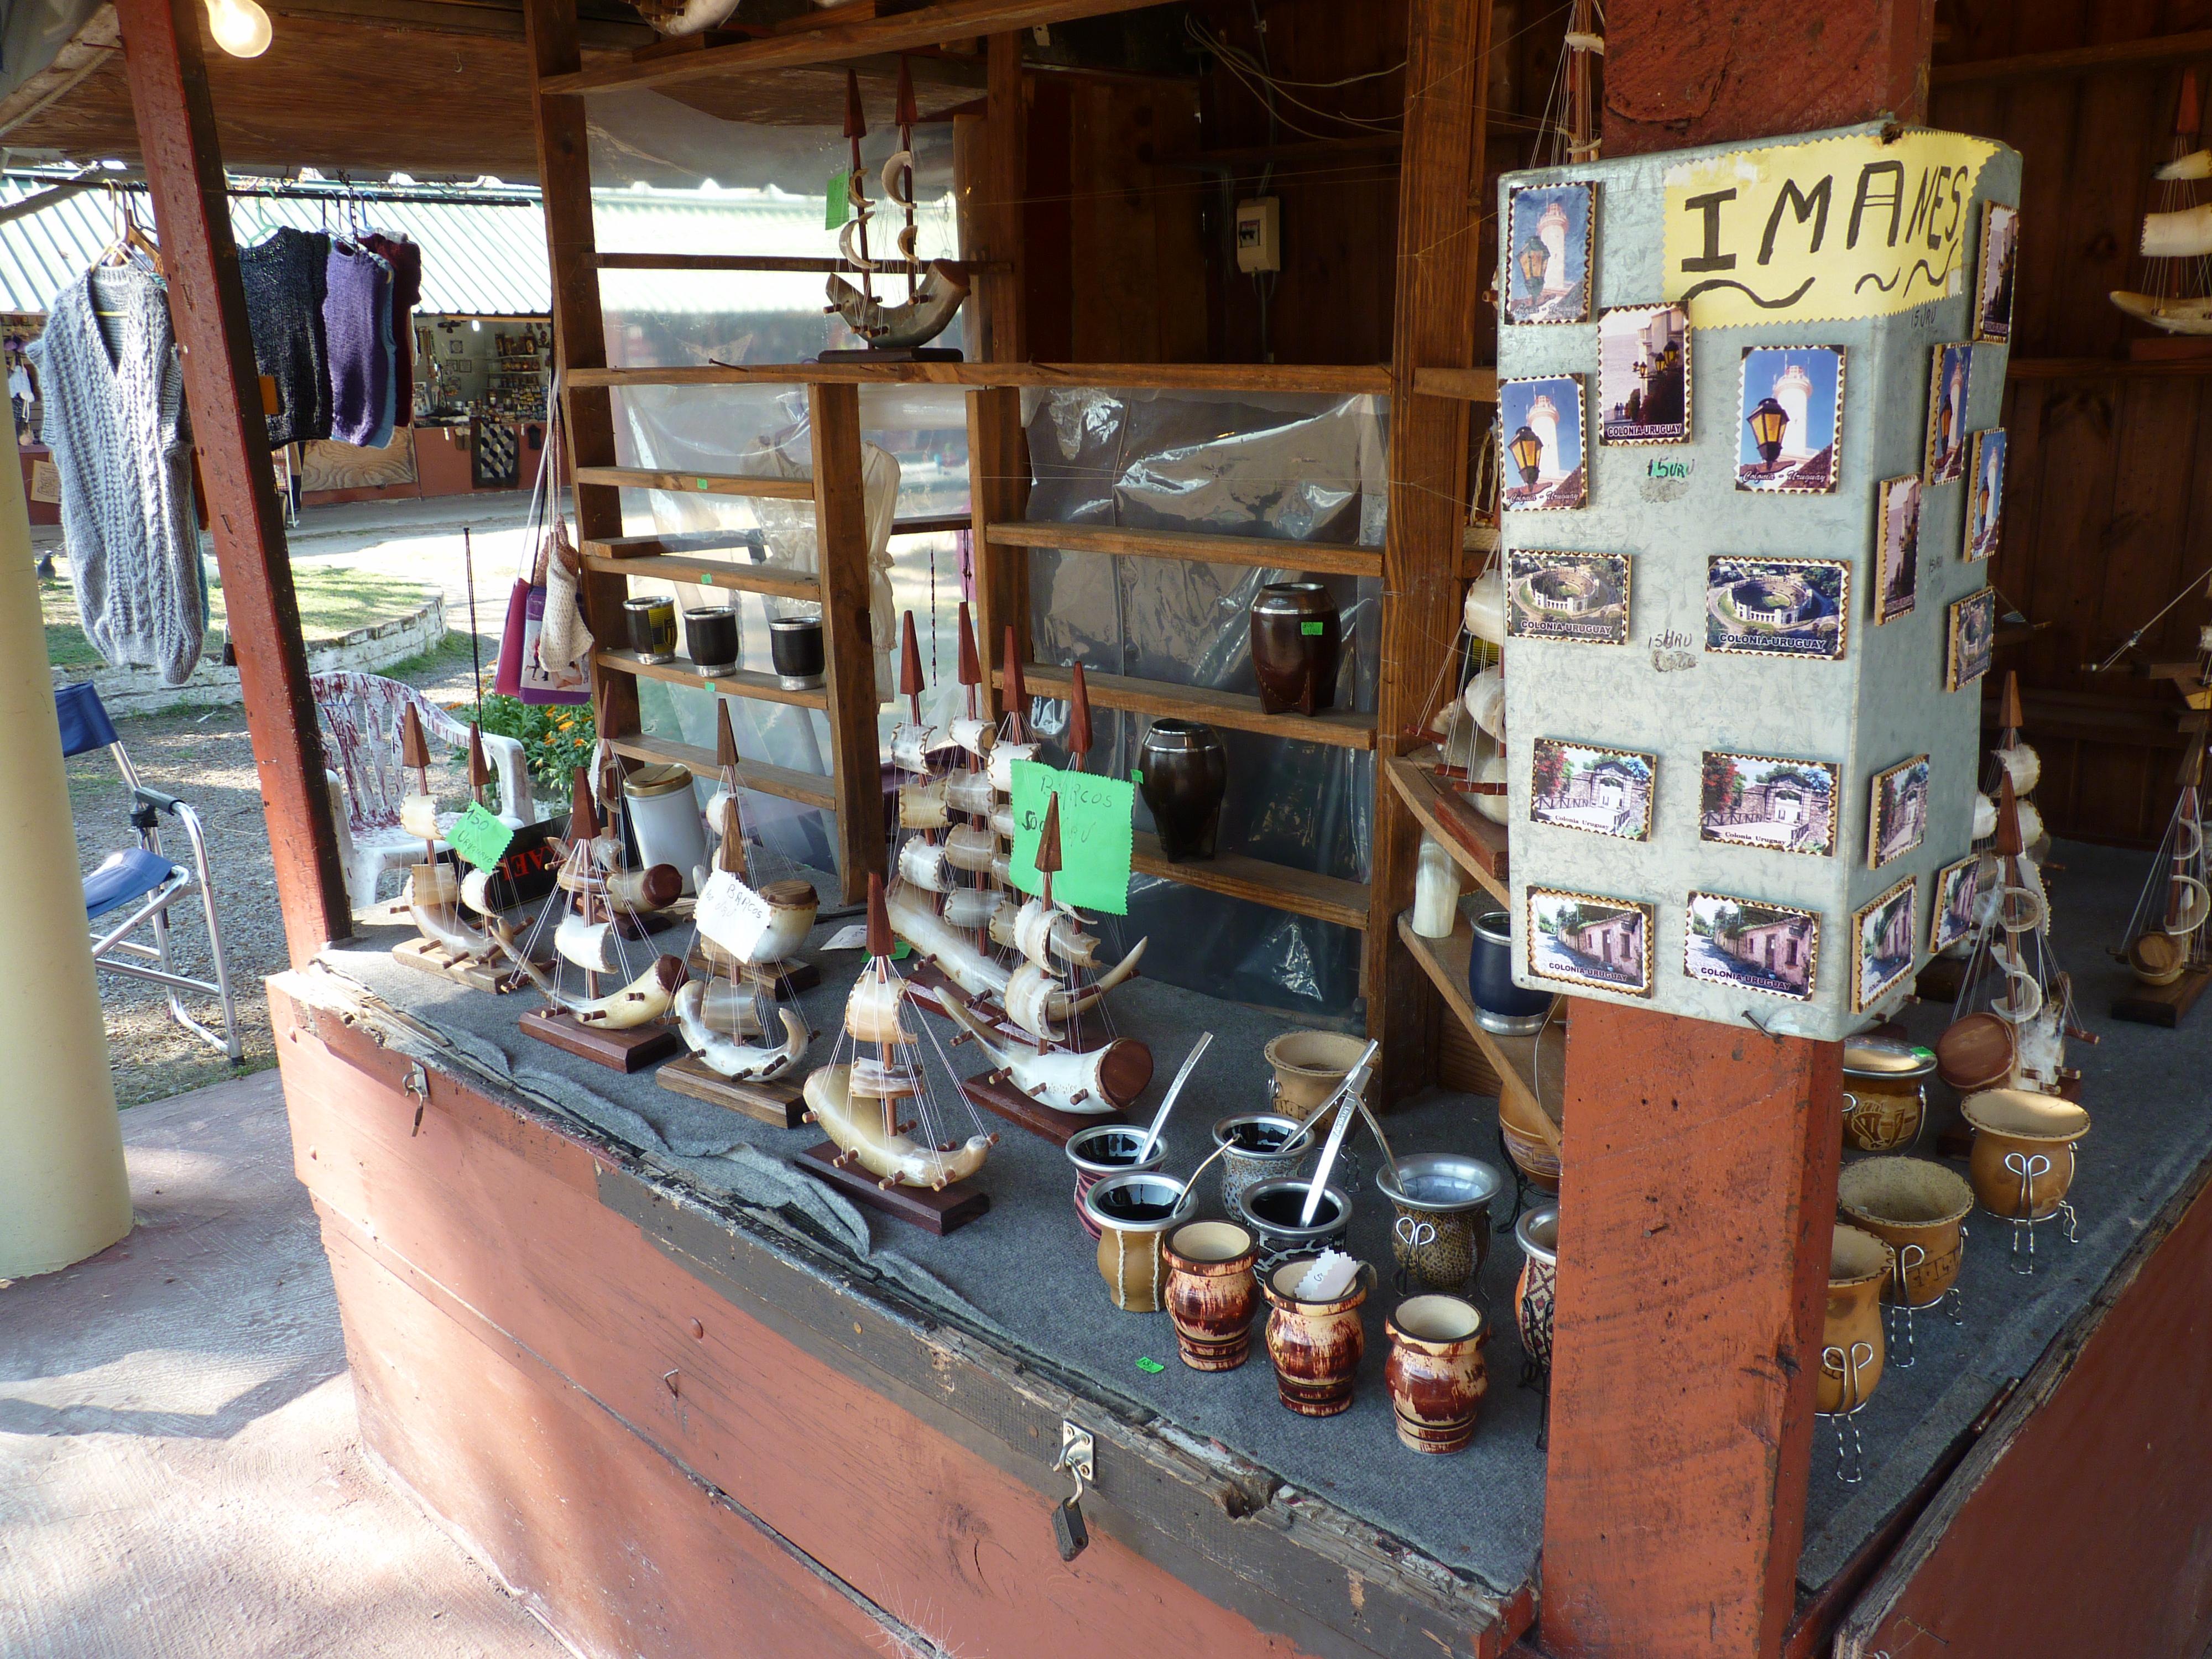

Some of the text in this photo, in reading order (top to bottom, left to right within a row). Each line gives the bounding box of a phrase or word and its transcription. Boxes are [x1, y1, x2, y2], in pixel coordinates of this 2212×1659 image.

[1681, 160, 1968, 272] IMANES
[1743, 471, 1775, 484] Colonia
[1786, 470, 1825, 483] Uruguay
[467, 809, 489, 831] 150
[1555, 815, 1610, 830] Colonia Uruguay
[1725, 832, 1786, 845] Colonia Uruguay
[727, 884, 763, 919] BARCOS
